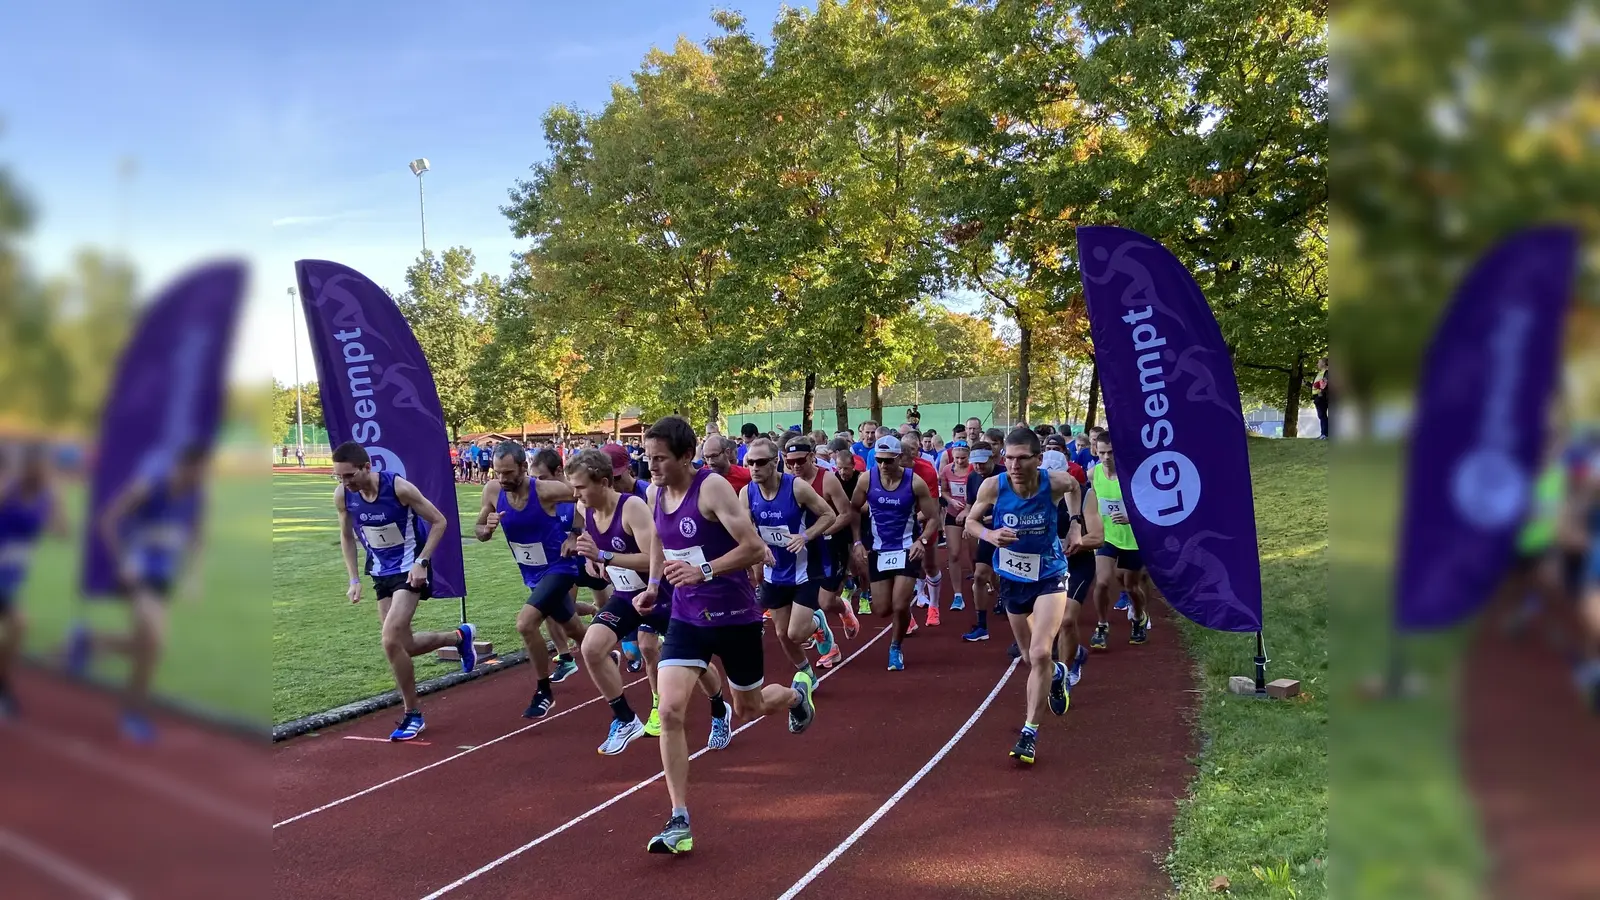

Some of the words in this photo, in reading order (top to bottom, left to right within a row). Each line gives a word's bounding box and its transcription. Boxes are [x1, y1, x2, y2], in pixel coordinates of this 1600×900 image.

[1121, 305, 1174, 449] Sempt
[333, 327, 381, 443] Sempt
[1150, 459, 1184, 517] LG
[379, 534, 386, 542] 1
[771, 532, 782, 541] 10
[523, 551, 531, 560] 2
[885, 557, 898, 565] 40
[1005, 558, 1032, 573] 443
[619, 574, 631, 585] 11
